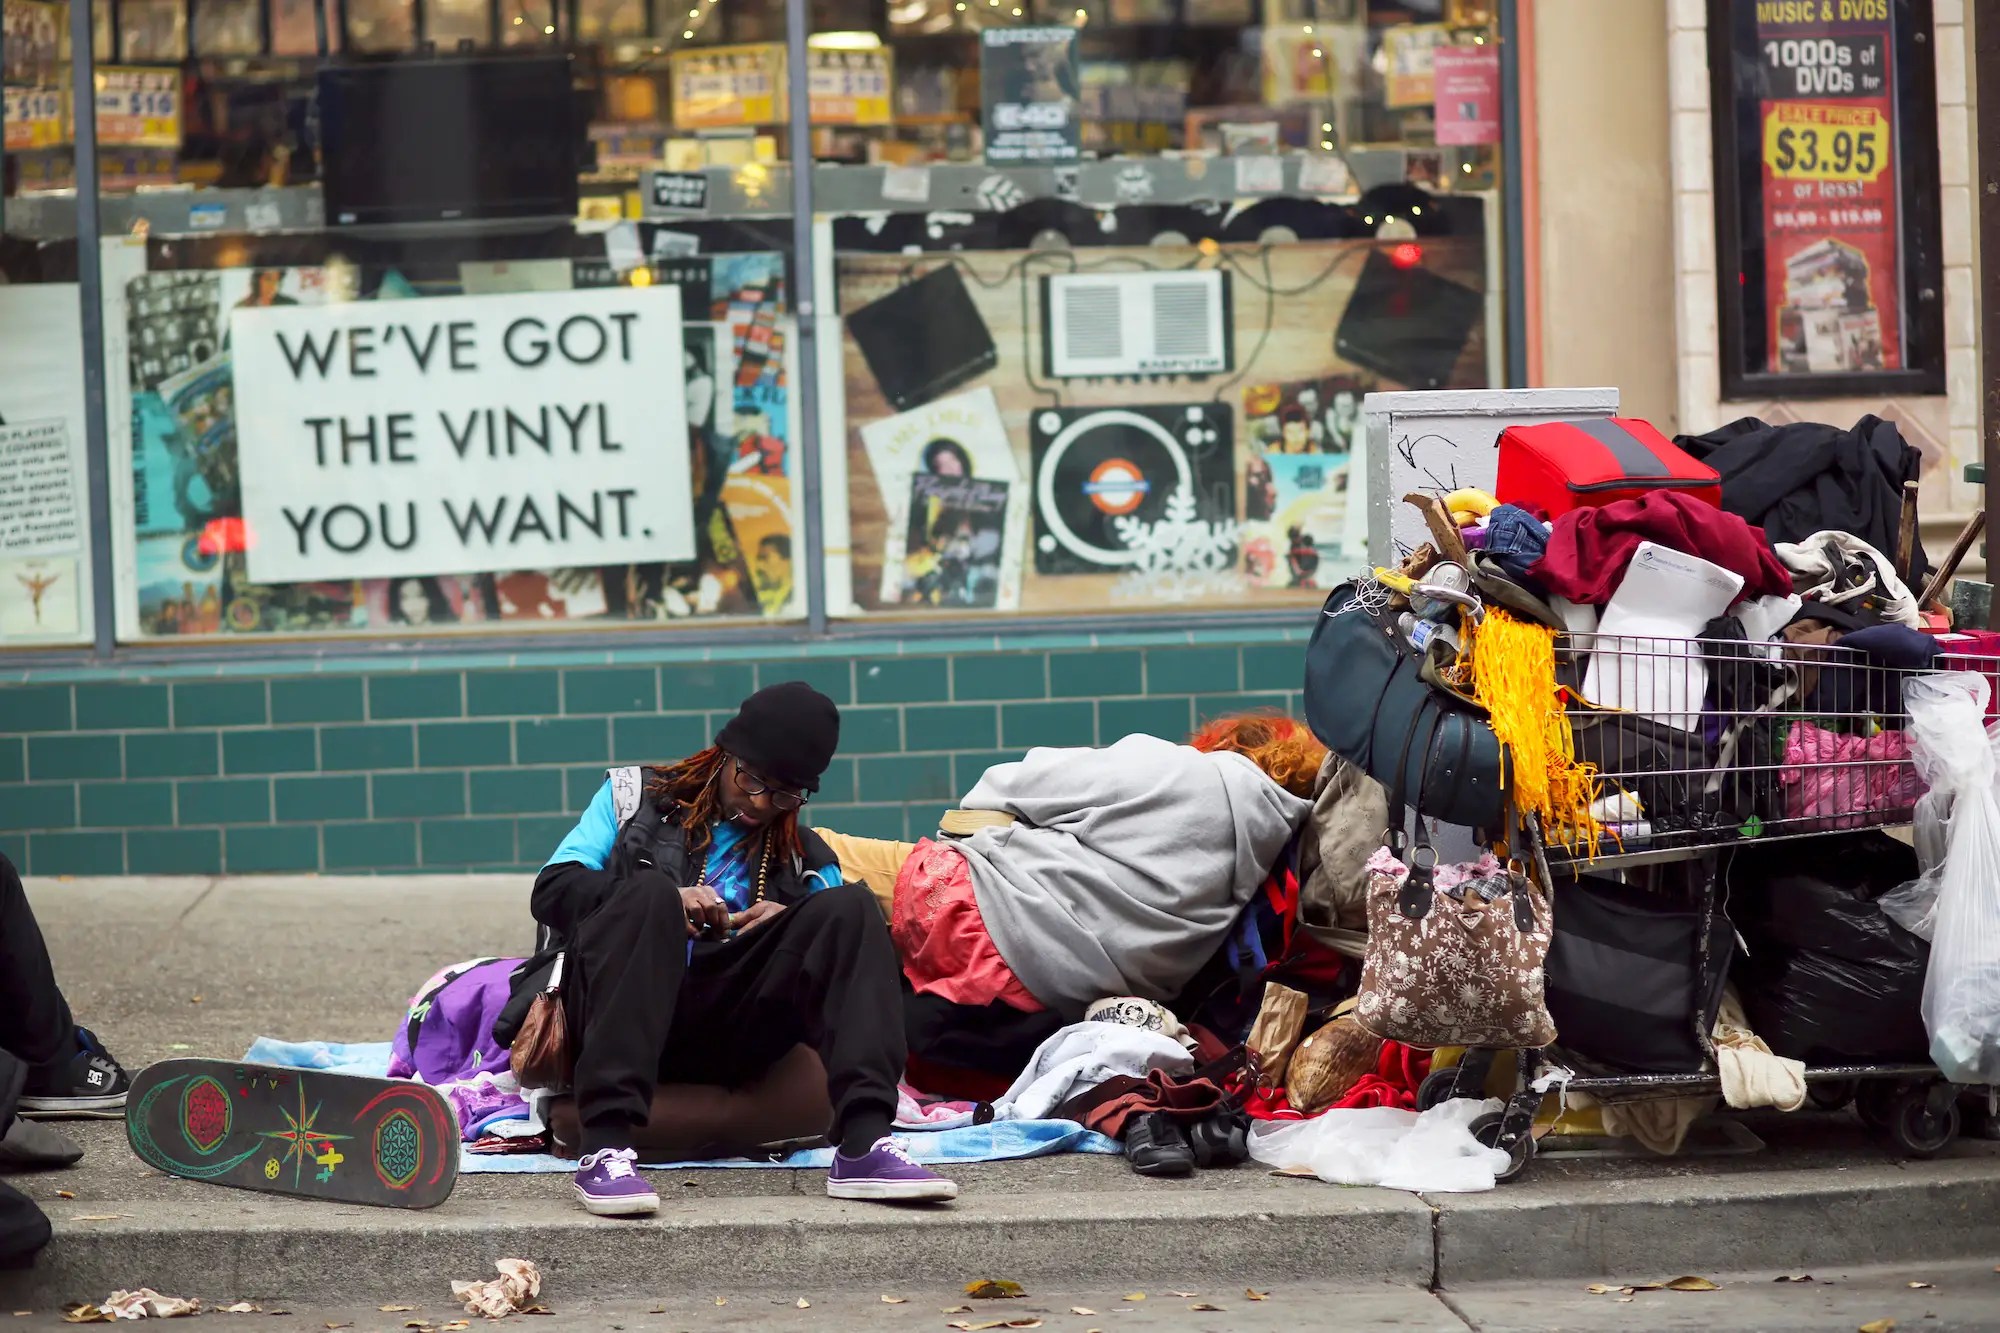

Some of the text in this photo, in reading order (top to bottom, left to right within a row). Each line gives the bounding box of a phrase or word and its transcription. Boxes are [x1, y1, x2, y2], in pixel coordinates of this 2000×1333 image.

[1757, 0, 1887, 23] MUSIC & DVDS
[1764, 39, 1876, 67] 1000s of
[1796, 66, 1854, 93] DVDs
[1781, 106, 1873, 126] SALE PRICE
[1776, 127, 1877, 174] $3.95
[1793, 179, 1864, 198] or less!
[276, 313, 639, 378] WE'VE GOT
[303, 402, 622, 466] THE VINYL
[282, 489, 652, 555] YOU WANT.
